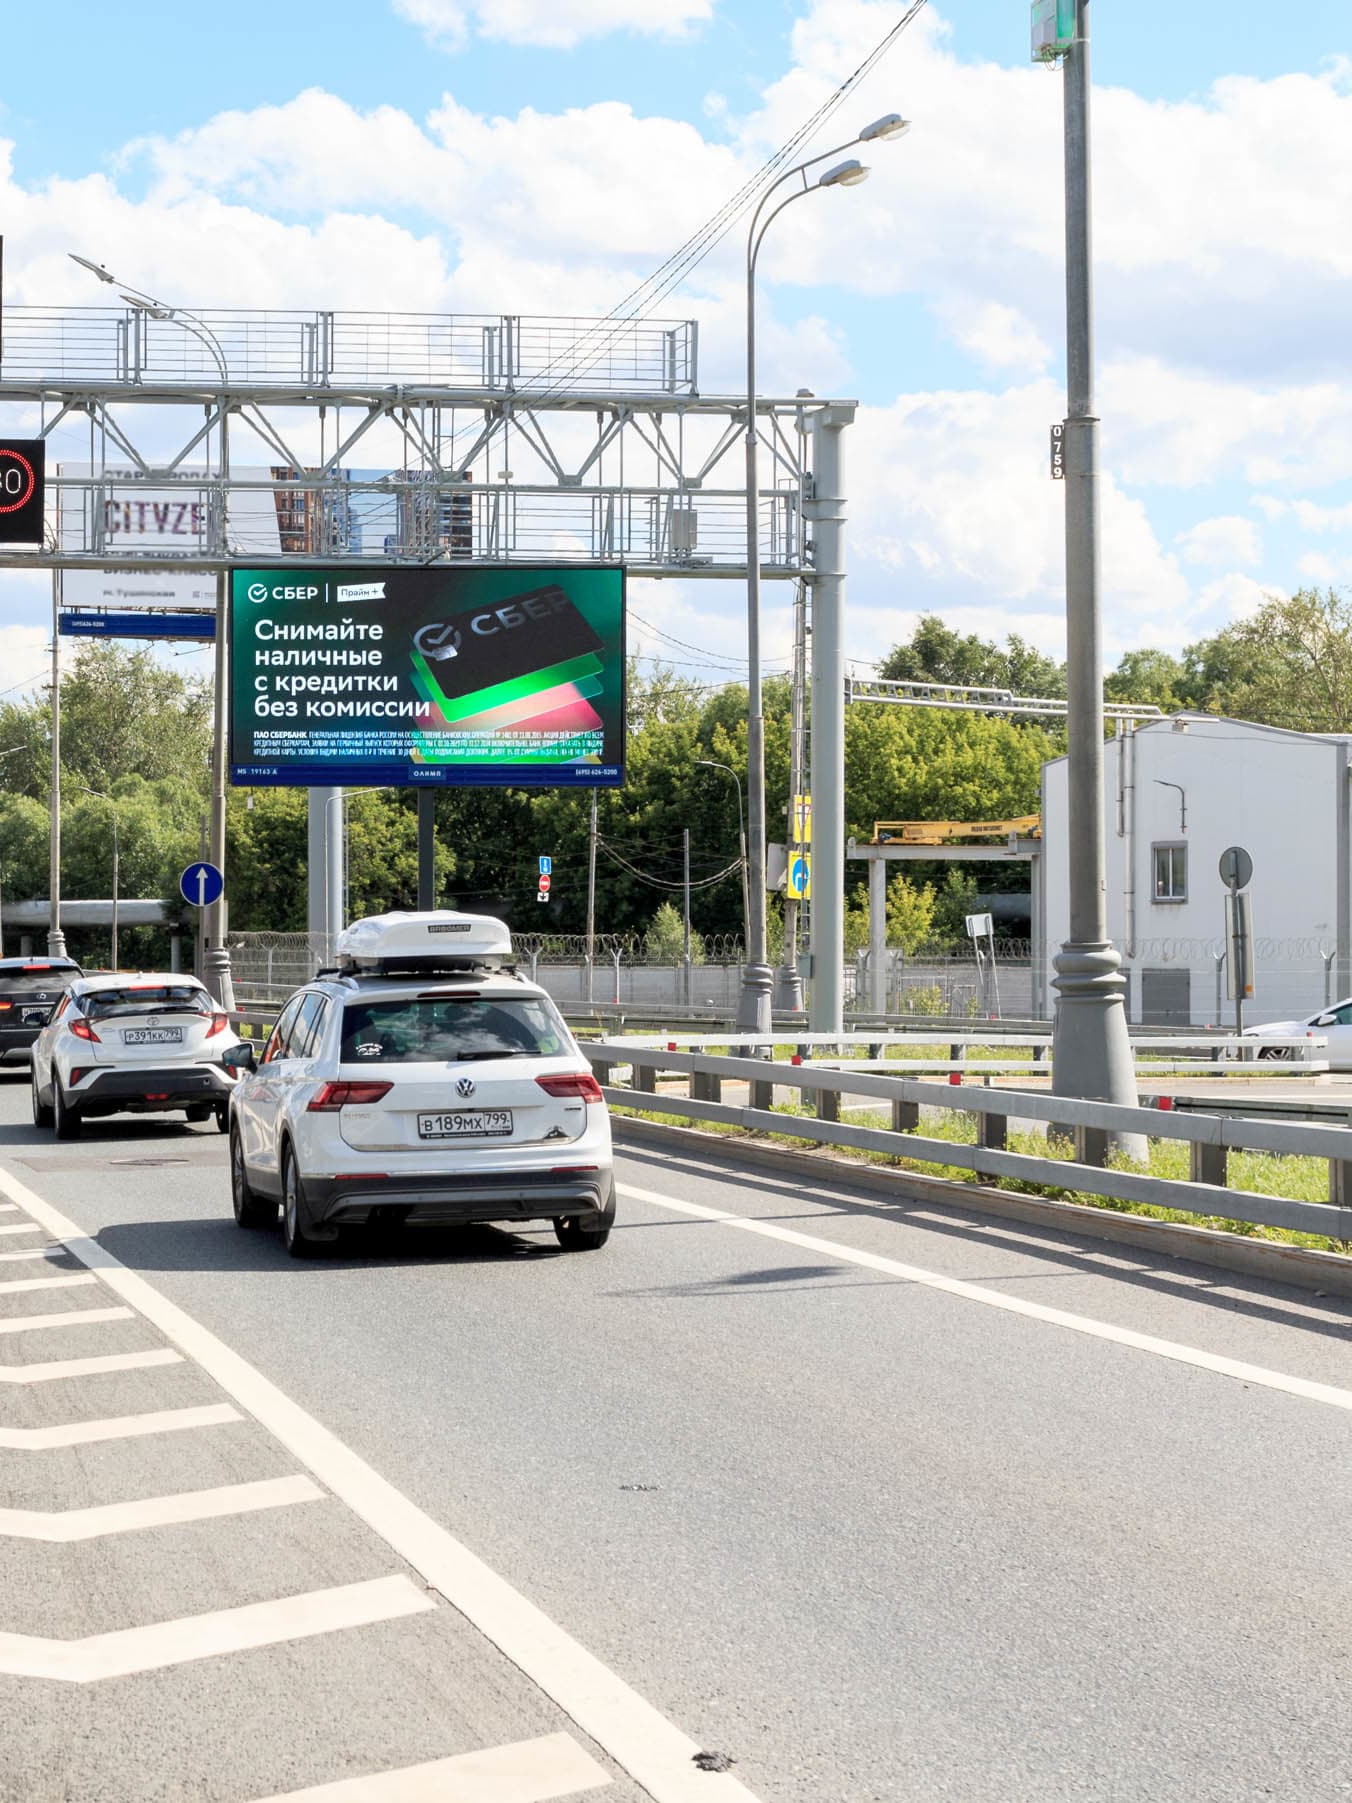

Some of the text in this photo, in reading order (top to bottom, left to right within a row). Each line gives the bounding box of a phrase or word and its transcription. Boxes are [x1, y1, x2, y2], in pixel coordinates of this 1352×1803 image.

[272, 586, 318, 600] СБЕР
[254, 617, 384, 641] Снимайте
[255, 650, 383, 666] наличные
[254, 675, 398, 696] с кредитки
[254, 694, 430, 717] без комиссии
[253, 731, 269, 739] ПАО
